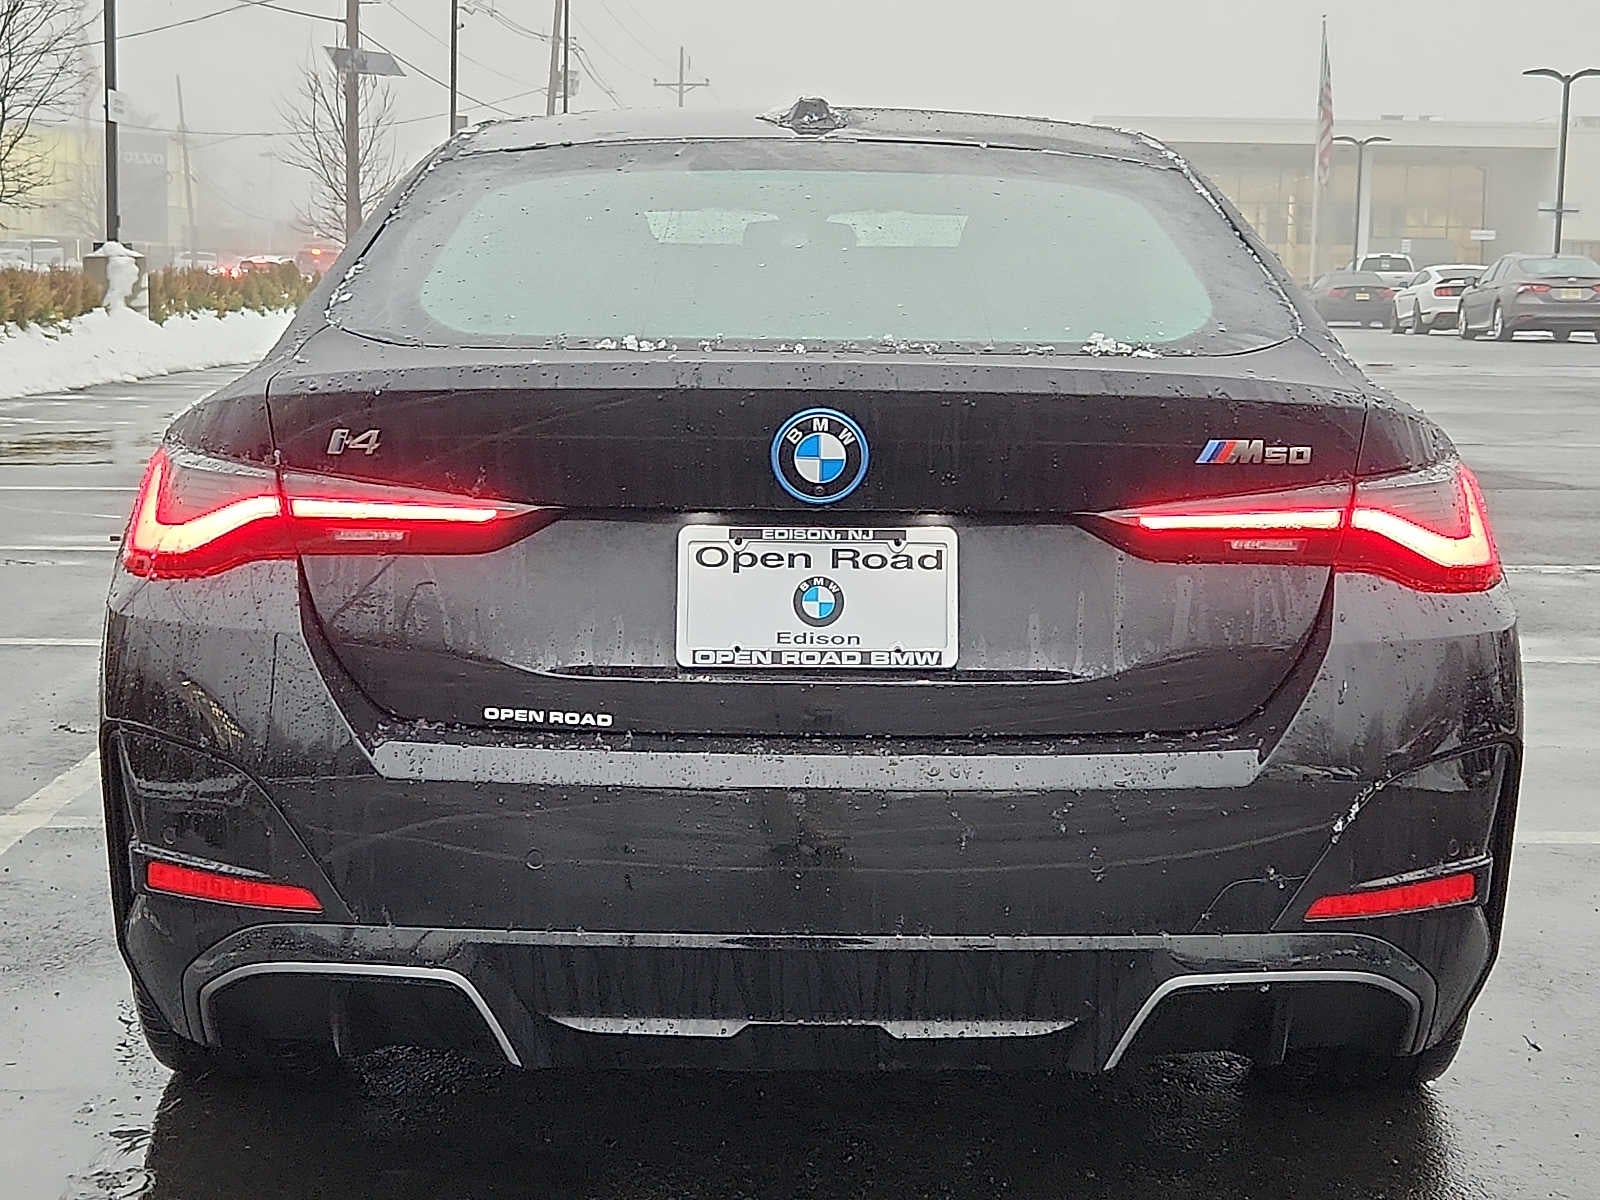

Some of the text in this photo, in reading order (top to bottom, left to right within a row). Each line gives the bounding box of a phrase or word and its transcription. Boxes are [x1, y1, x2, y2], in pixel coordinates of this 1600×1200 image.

[785, 417, 856, 445] BMW
[326, 428, 381, 455] i4
[1224, 439, 1312, 465] M50
[762, 529, 874, 541] EDISON, NJ
[695, 546, 943, 573] Open Road
[799, 577, 840, 593] BMW
[776, 632, 861, 645] Edison
[694, 649, 940, 665] OPEN ROAD BMW
[484, 707, 613, 727] OPEN ROAD
